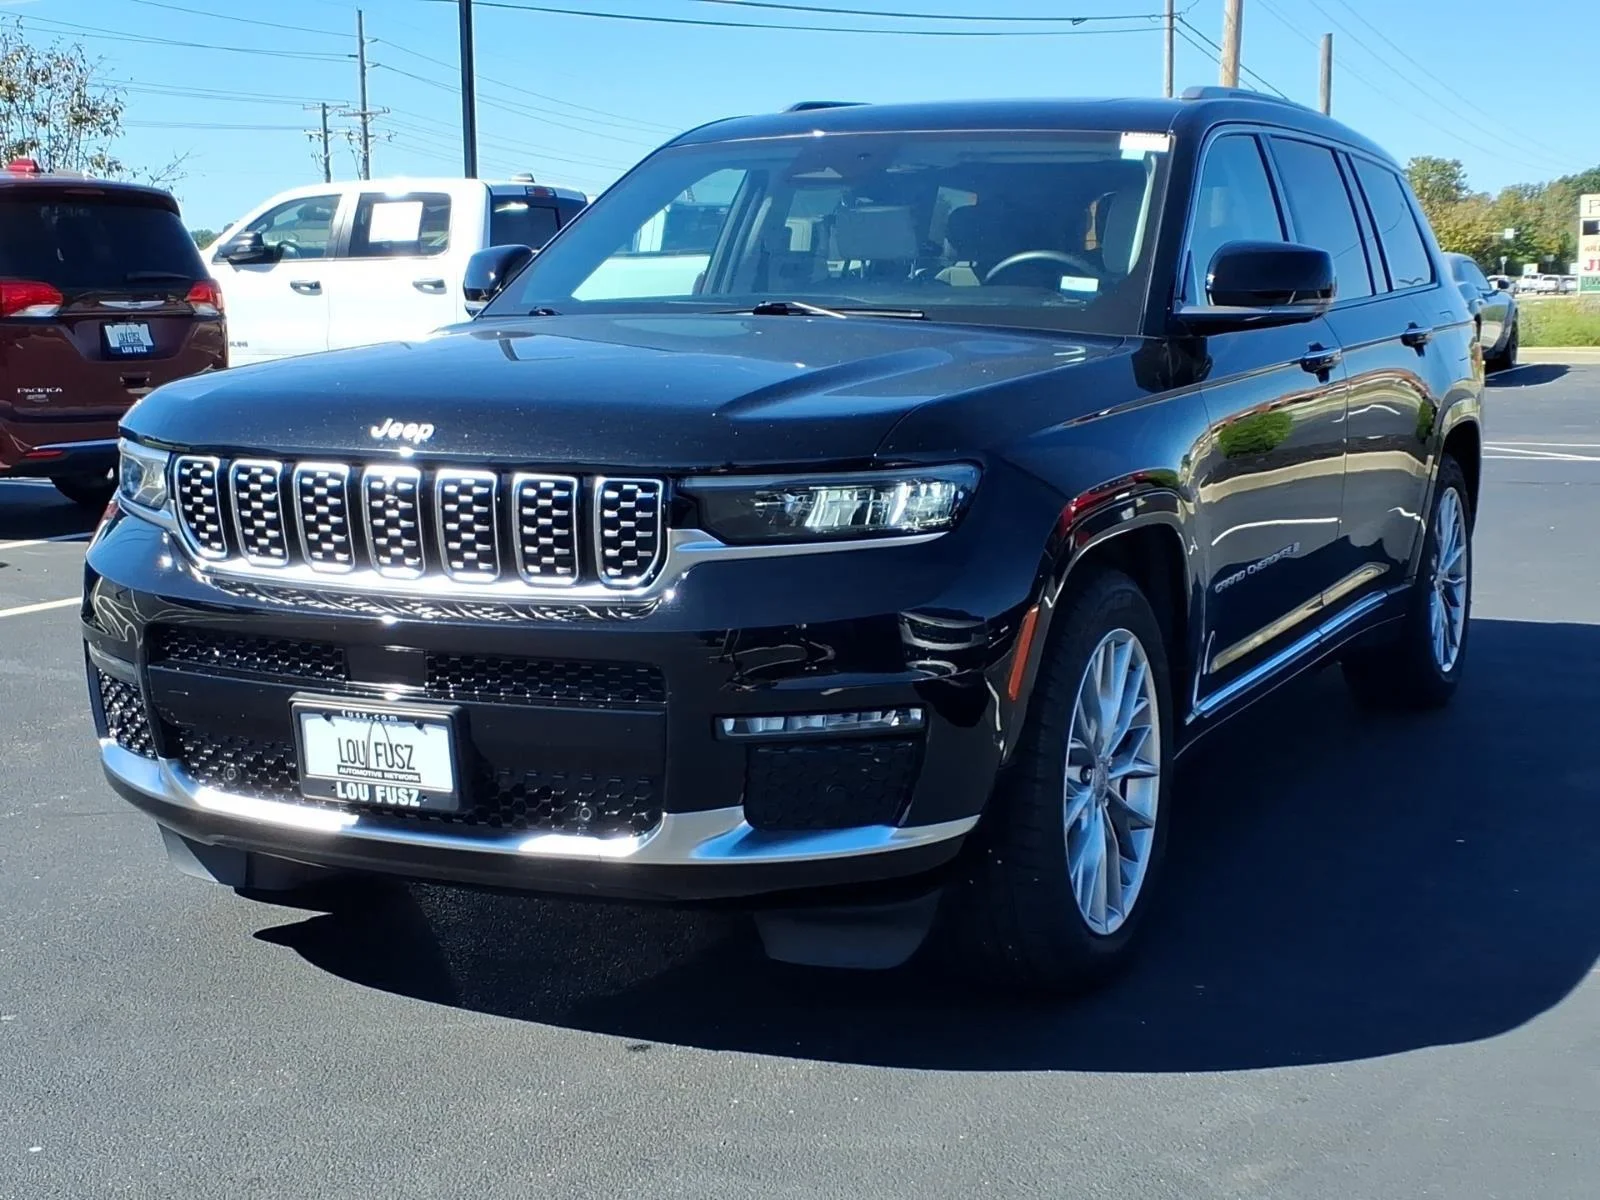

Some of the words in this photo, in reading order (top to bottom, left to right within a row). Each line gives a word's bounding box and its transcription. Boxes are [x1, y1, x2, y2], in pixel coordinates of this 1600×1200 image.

[370, 417, 435, 445] Jeep
[337, 736, 366, 766] LOU
[373, 741, 416, 770] FUSZ
[338, 766, 383, 779] AUTOMOTIVE
[383, 771, 421, 782] NETWORK
[336, 781, 370, 801] LOU
[375, 785, 421, 807] FUSZ
